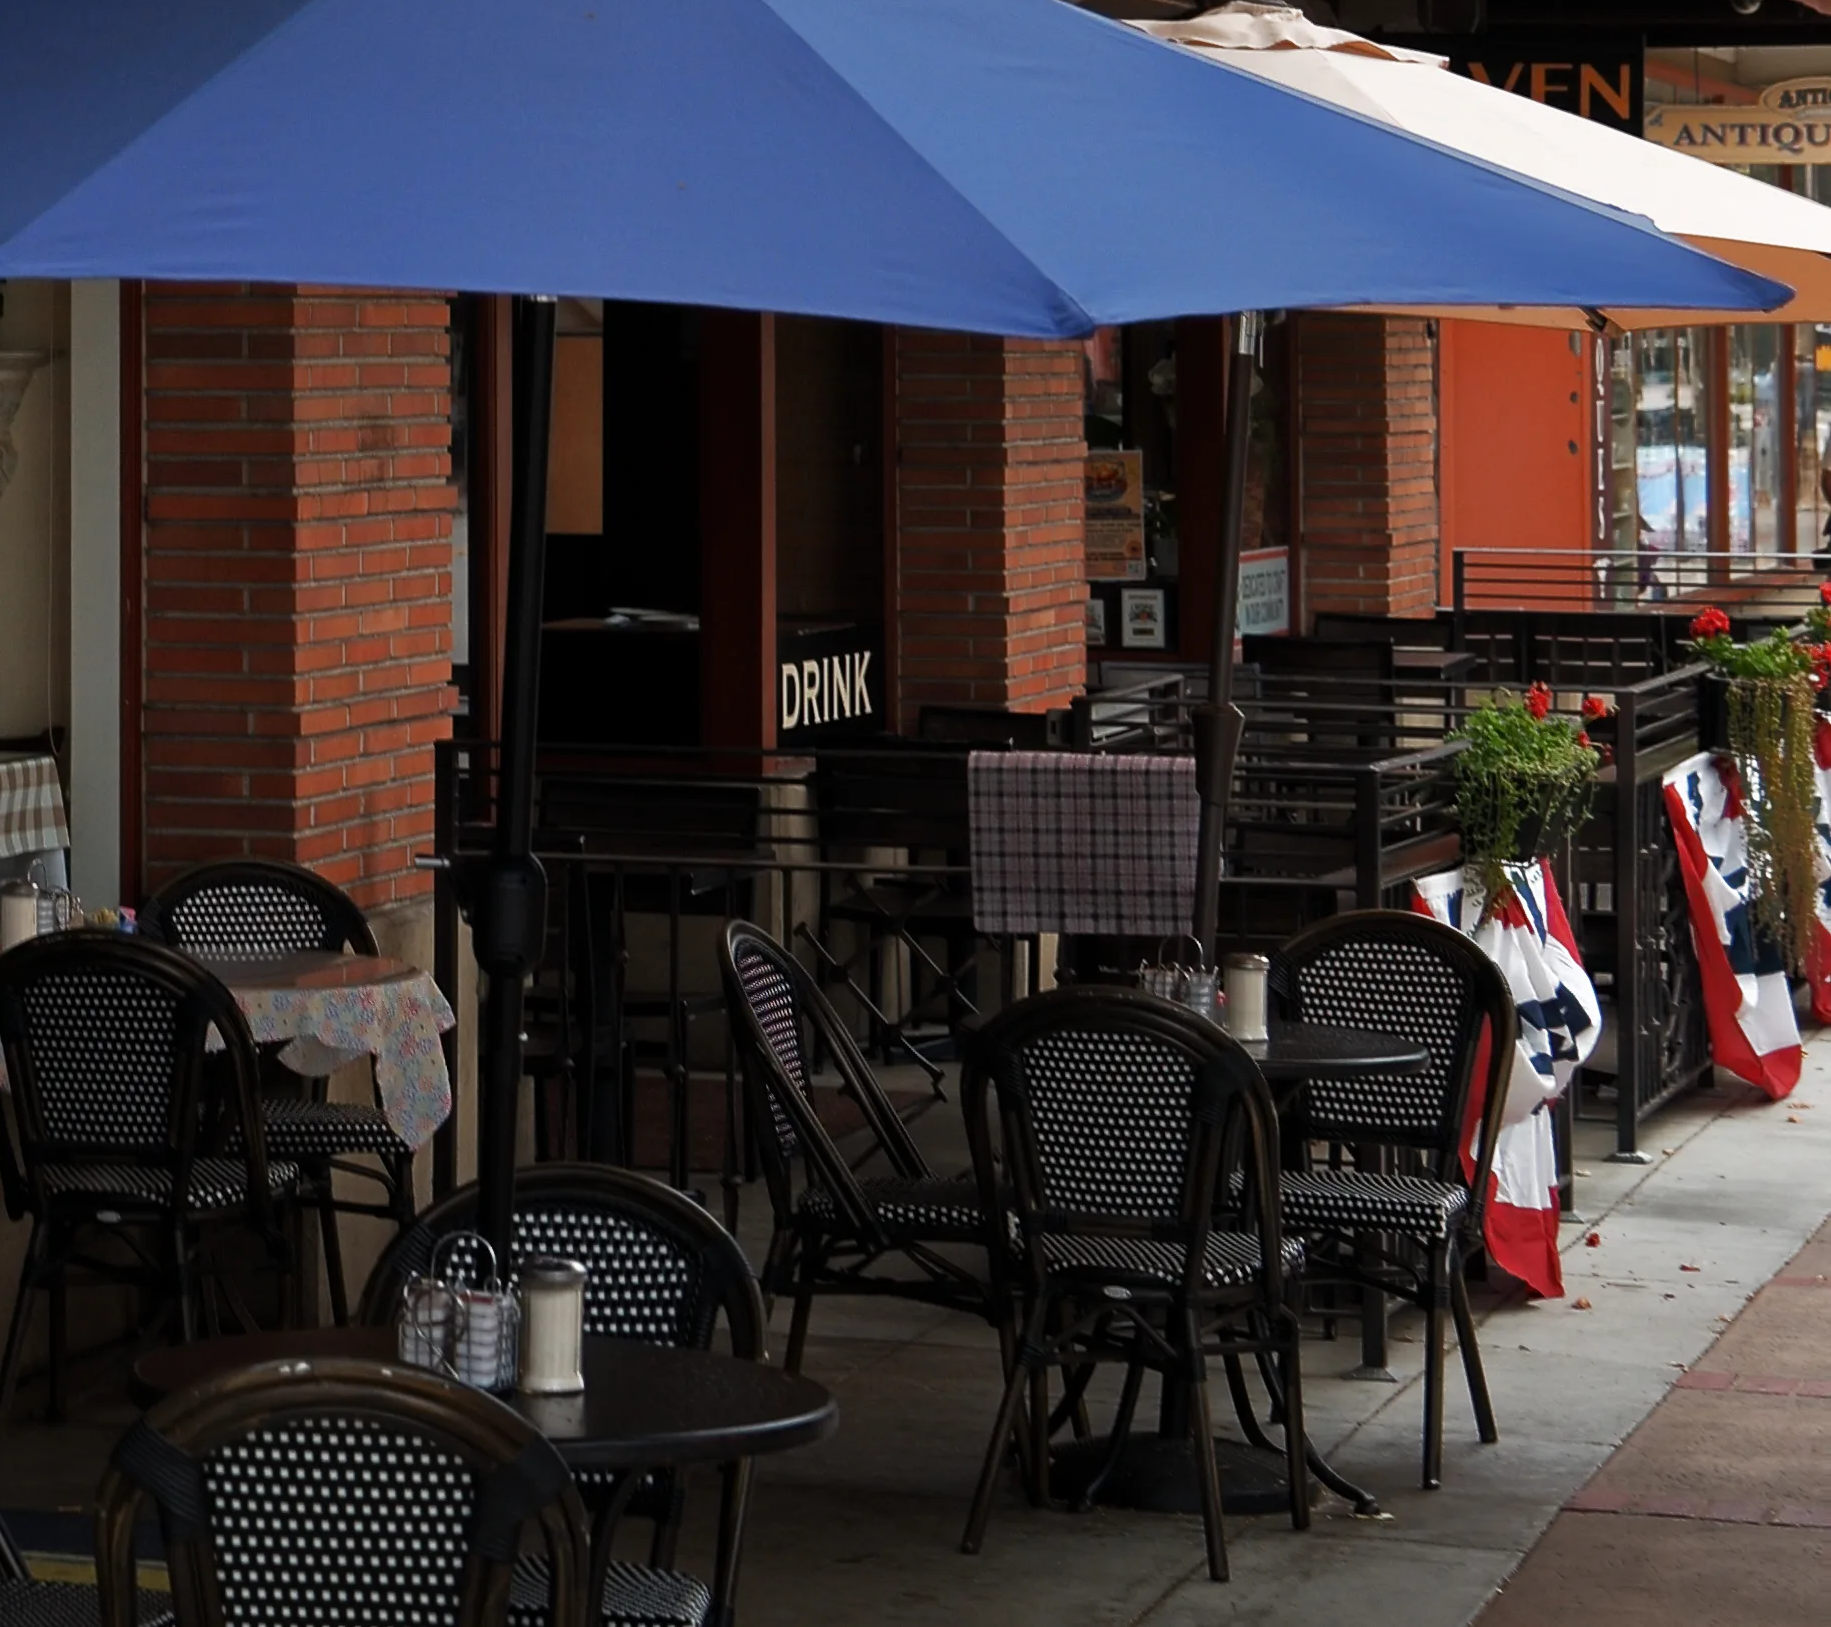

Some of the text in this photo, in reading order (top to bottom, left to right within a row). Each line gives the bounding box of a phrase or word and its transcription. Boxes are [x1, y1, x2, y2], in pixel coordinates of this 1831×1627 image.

[1778, 86, 1831, 109] ANTI
[1673, 122, 1831, 156] ANTIQU
[781, 650, 873, 730] DRINK
